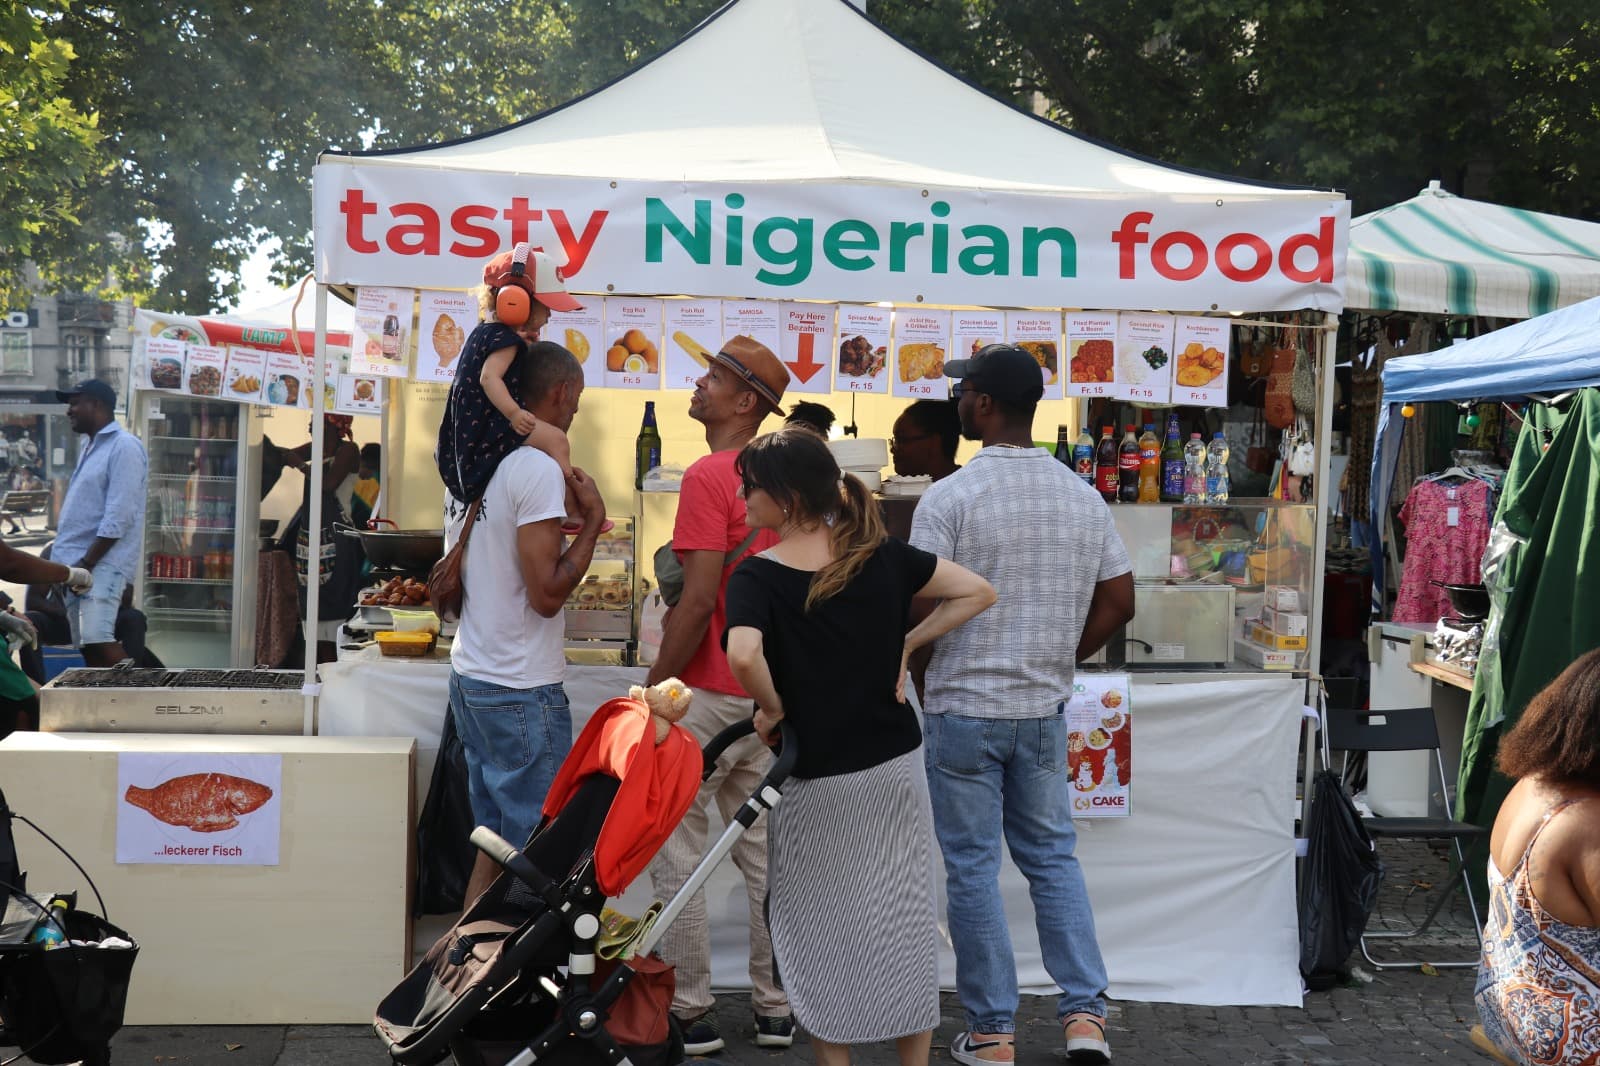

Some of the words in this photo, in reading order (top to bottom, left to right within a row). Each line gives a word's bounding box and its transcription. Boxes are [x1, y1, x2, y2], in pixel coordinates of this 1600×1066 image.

[339, 188, 609, 280] tasty
[644, 192, 1077, 287] Nigerian
[1111, 211, 1336, 283] food
[433, 298, 452, 306] Grilled
[622, 306, 634, 314] Egg
[789, 311, 805, 320] Pay
[806, 312, 826, 321] Here
[847, 314, 868, 322] Spiced
[788, 323, 825, 334] Bezahlen
[242, 327, 287, 345] LAMP
[370, 364, 381, 373] Fr.
[383, 364, 389, 373] 5
[434, 368, 447, 377] Fr.
[623, 376, 633, 384] Fr.
[635, 376, 641, 384] 5
[850, 381, 861, 390] Fr.
[863, 382, 873, 390] 15
[909, 385, 920, 393] Fr.
[921, 386, 931, 394] 30
[1081, 386, 1091, 394] Fr.
[1094, 386, 1104, 394] 15
[1130, 388, 1141, 397] Fr.
[155, 705, 224, 715] SELZAM
[1092, 796, 1125, 806] CAKE
[154, 844, 209, 857] ...leckerer
[212, 845, 243, 857] Fisch
